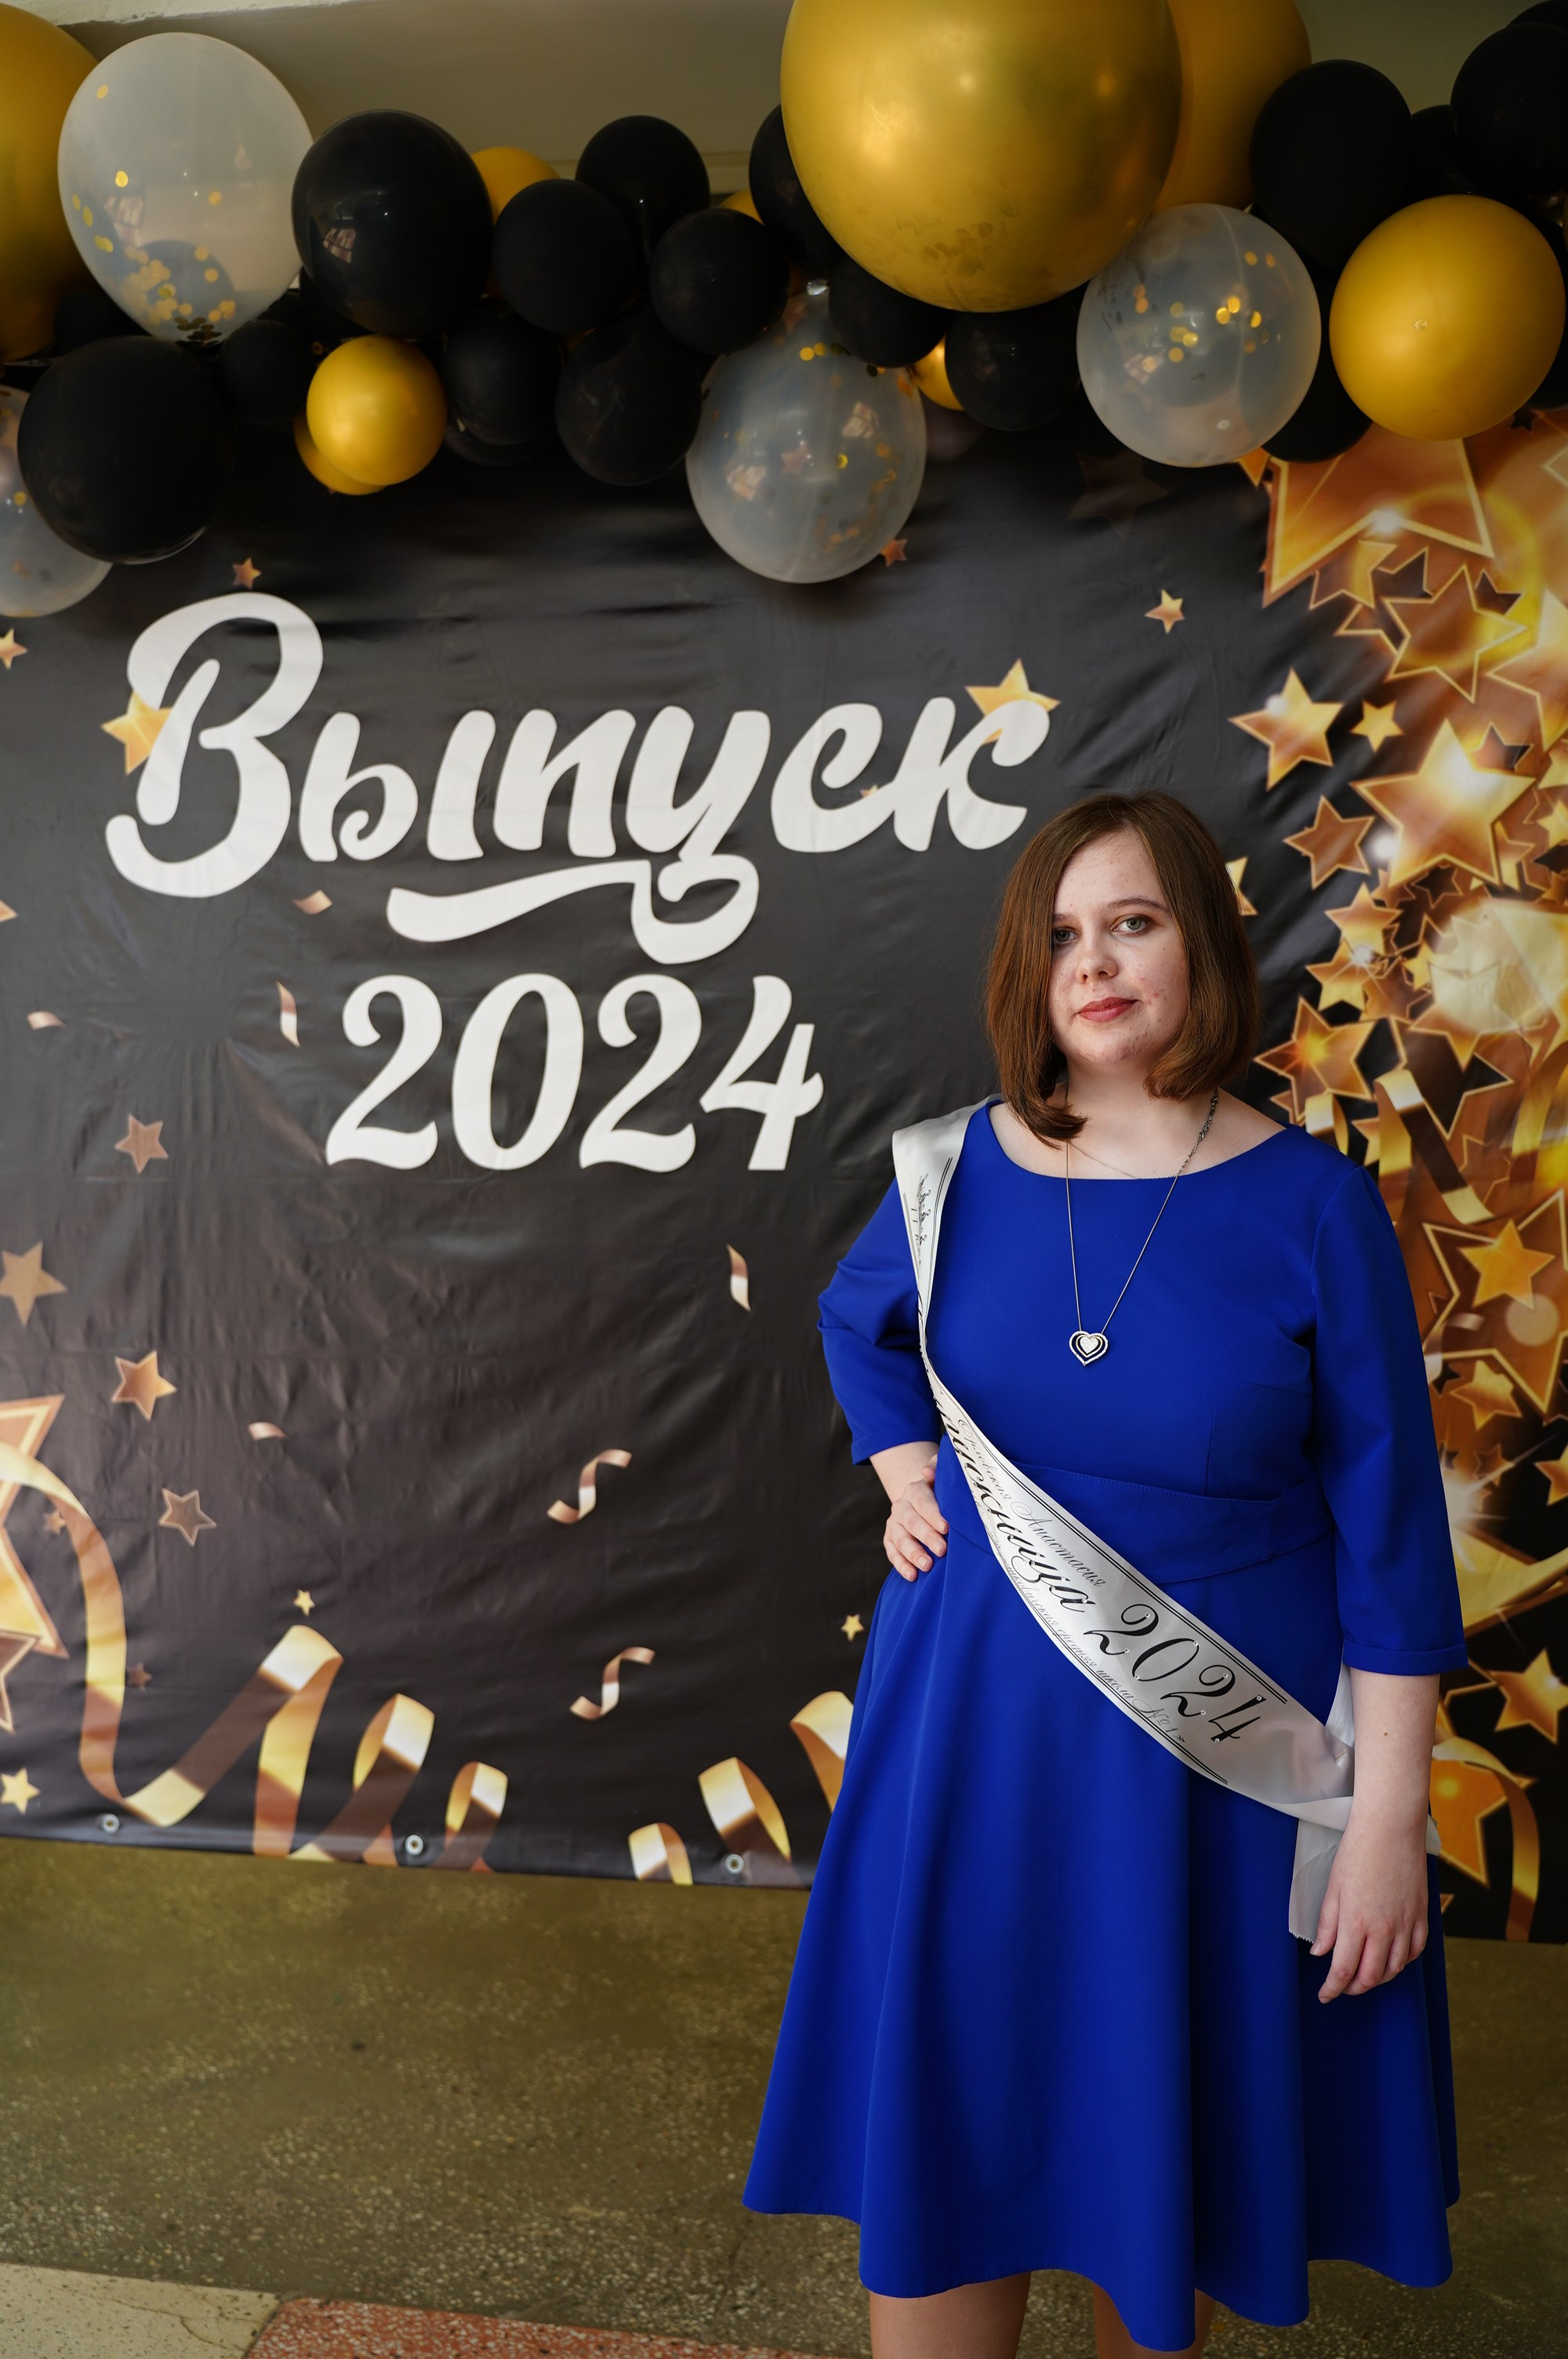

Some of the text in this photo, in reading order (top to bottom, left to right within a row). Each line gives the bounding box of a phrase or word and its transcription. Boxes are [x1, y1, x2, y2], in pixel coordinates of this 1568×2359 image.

[105, 592, 1051, 965] Выпуск
[325, 972, 824, 1172] 2024
[1010, 1501, 1106, 1587] Анастасия
[1083, 1603, 1267, 1744] 2024
[1096, 1670, 1134, 1700] школа
